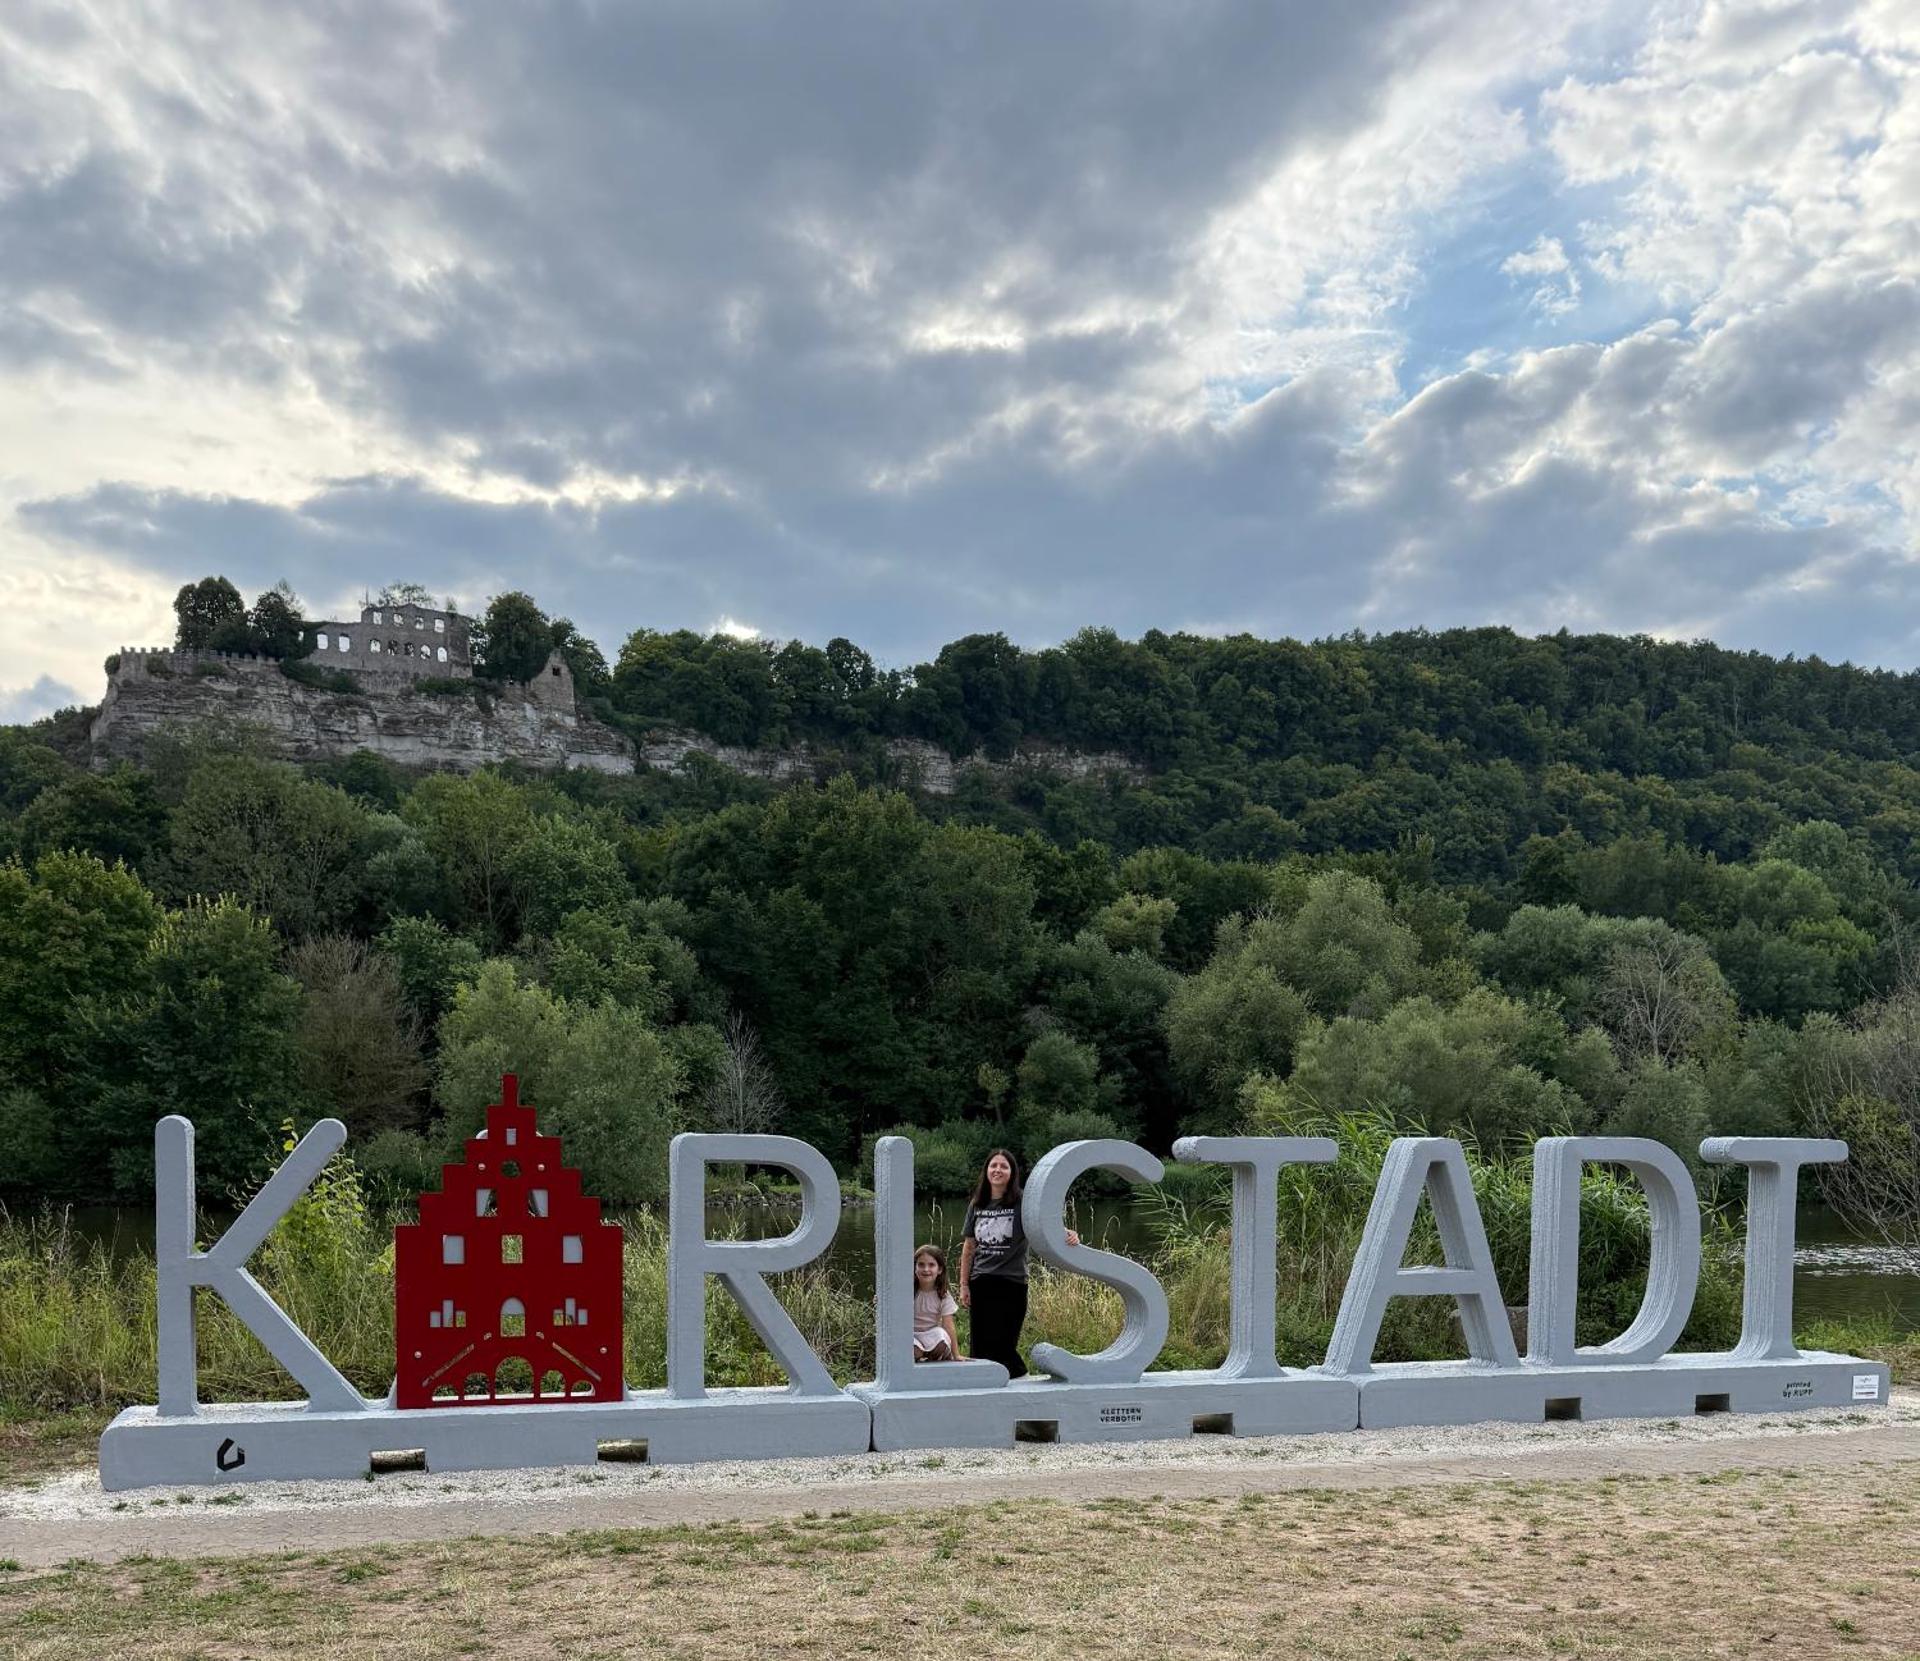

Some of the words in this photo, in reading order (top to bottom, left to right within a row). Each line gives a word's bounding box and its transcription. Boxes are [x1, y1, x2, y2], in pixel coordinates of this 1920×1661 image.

[155, 1115, 1849, 1413] KRLSTADT
[1100, 1407, 1141, 1415] KLETTERN
[1100, 1415, 1141, 1423] VERBOTEN
